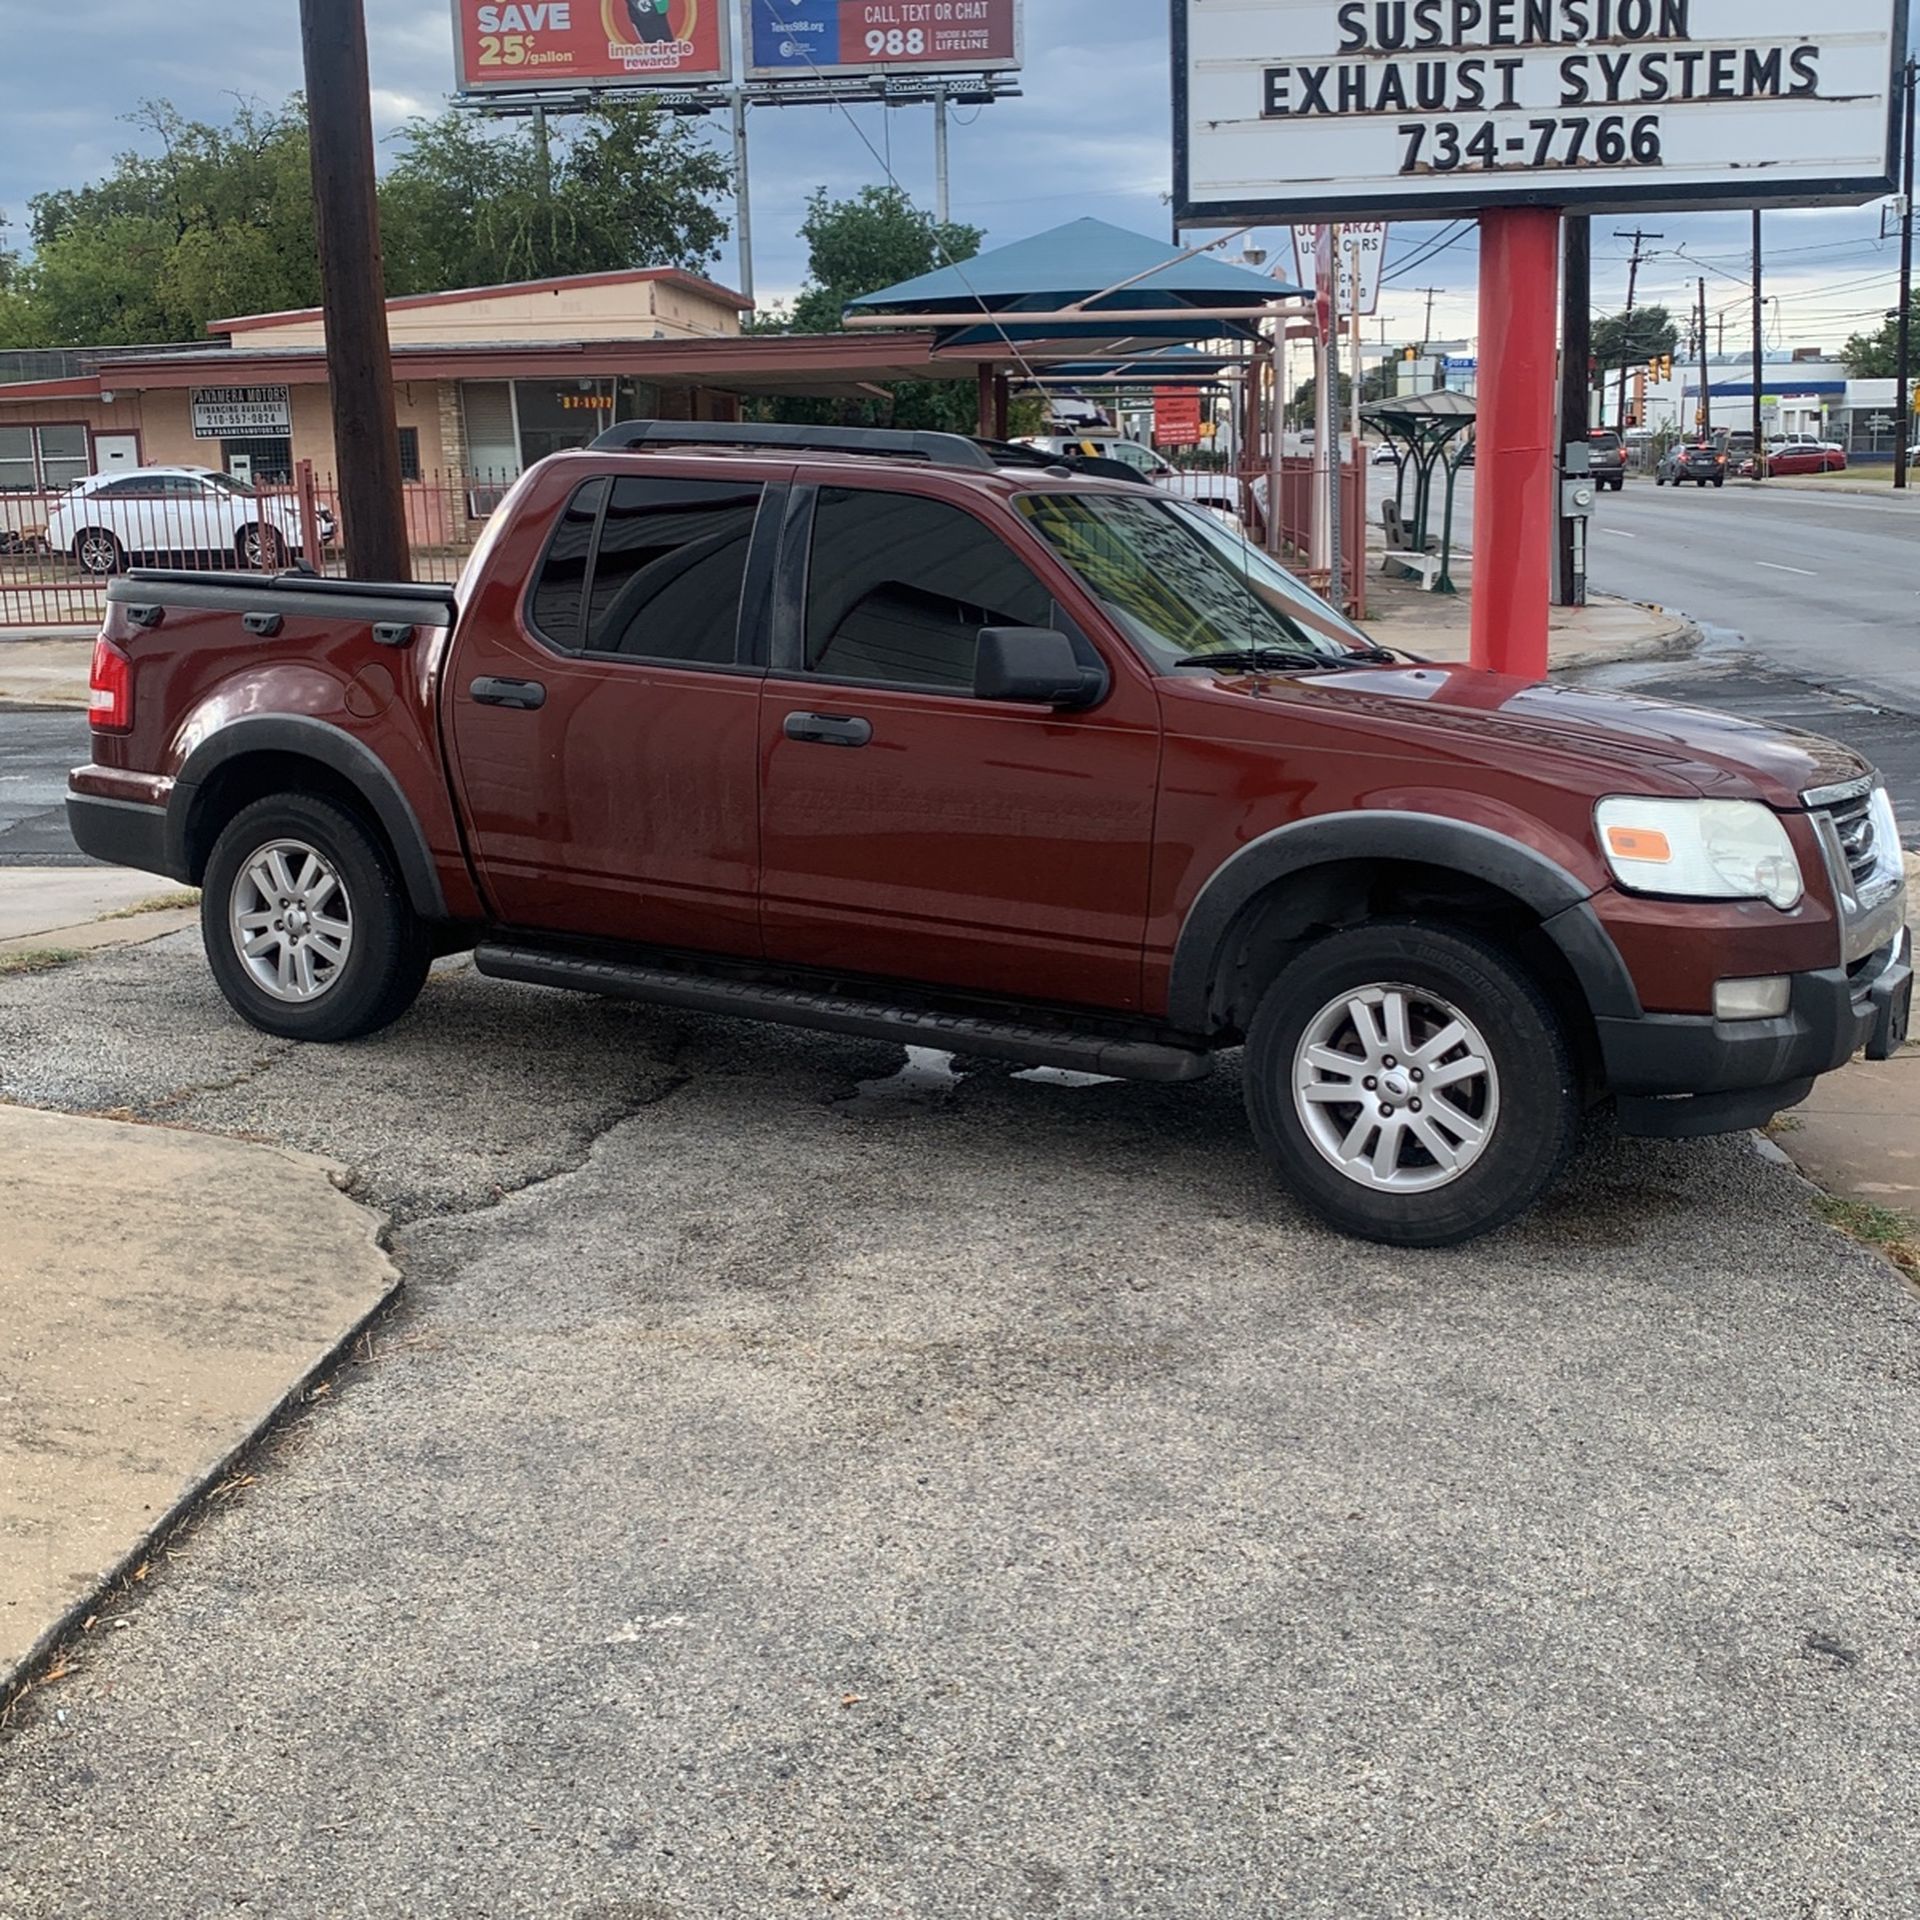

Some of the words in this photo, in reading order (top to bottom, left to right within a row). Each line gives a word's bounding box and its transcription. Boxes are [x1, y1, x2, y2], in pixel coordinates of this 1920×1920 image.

[478, 3, 571, 33] SAVE
[865, 6, 900, 24] CALL,
[902, 4, 931, 21] TEXT
[935, 3, 952, 20] OR
[956, 2, 988, 19] CHAT
[1338, 0, 1688, 52] SUSPENSION
[610, 41, 692, 57] innercircle
[865, 28, 924, 56] 988
[936, 39, 989, 50] LIFELINE
[626, 56, 677, 67] rewards
[1264, 57, 1523, 115] EXHAUST
[1560, 46, 1819, 104] SYSTEMS
[1399, 115, 1661, 171] 734-7766
[1343, 238, 1378, 252] CRS
[193, 389, 244, 404] PANAMERA
[247, 387, 286, 402] MOTORS
[198, 405, 238, 414] FINANCING
[241, 403, 282, 413] AVAILABLE
